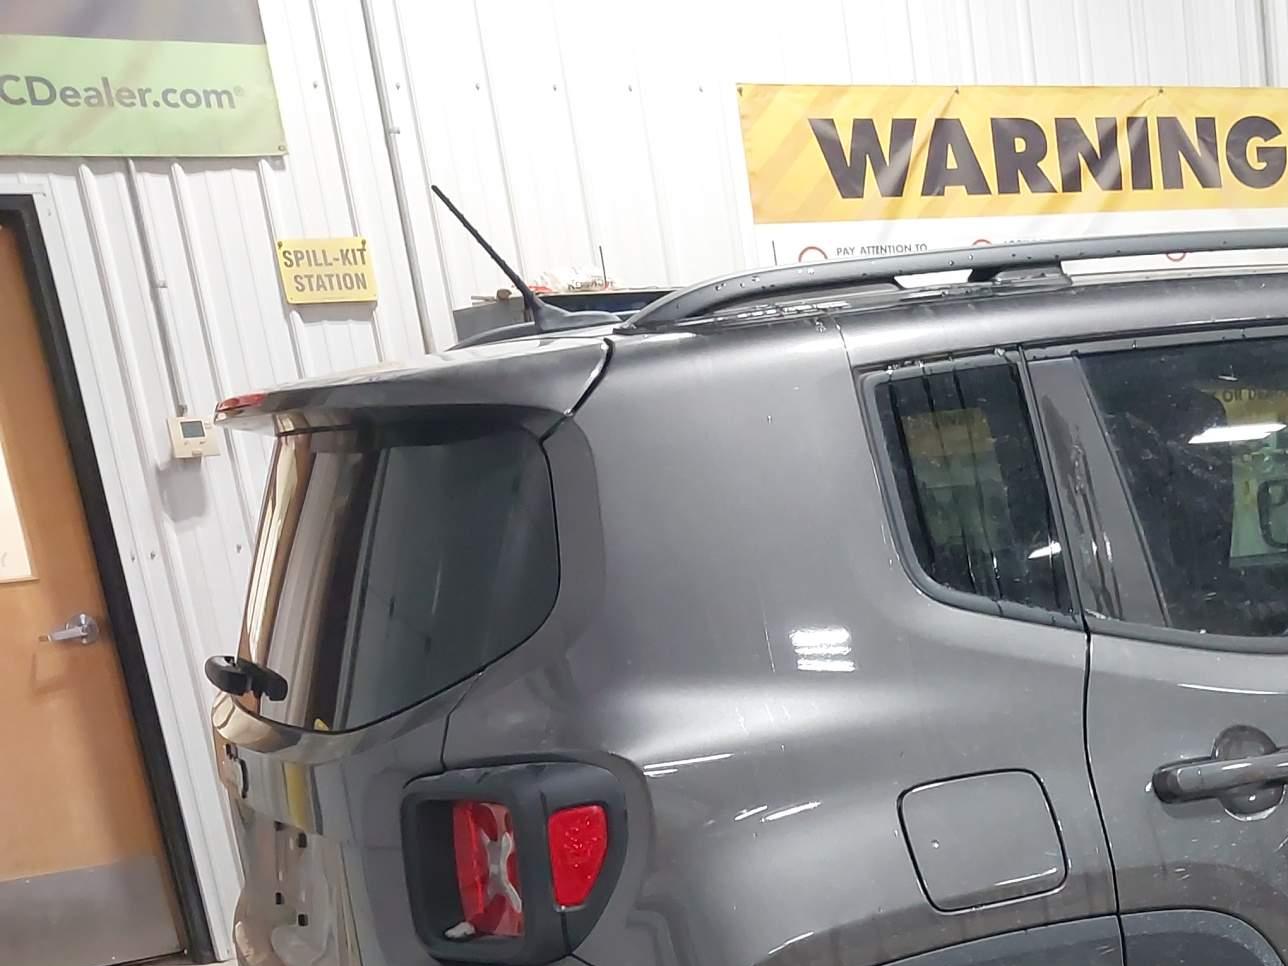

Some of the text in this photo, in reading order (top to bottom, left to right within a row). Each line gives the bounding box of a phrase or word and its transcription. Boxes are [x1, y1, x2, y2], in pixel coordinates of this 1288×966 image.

[808, 116, 1287, 199] WARNING
[282, 247, 367, 268] SPILL-KIT
[837, 243, 928, 256] PAY ATTENTION TO
[294, 272, 367, 292] STATION
